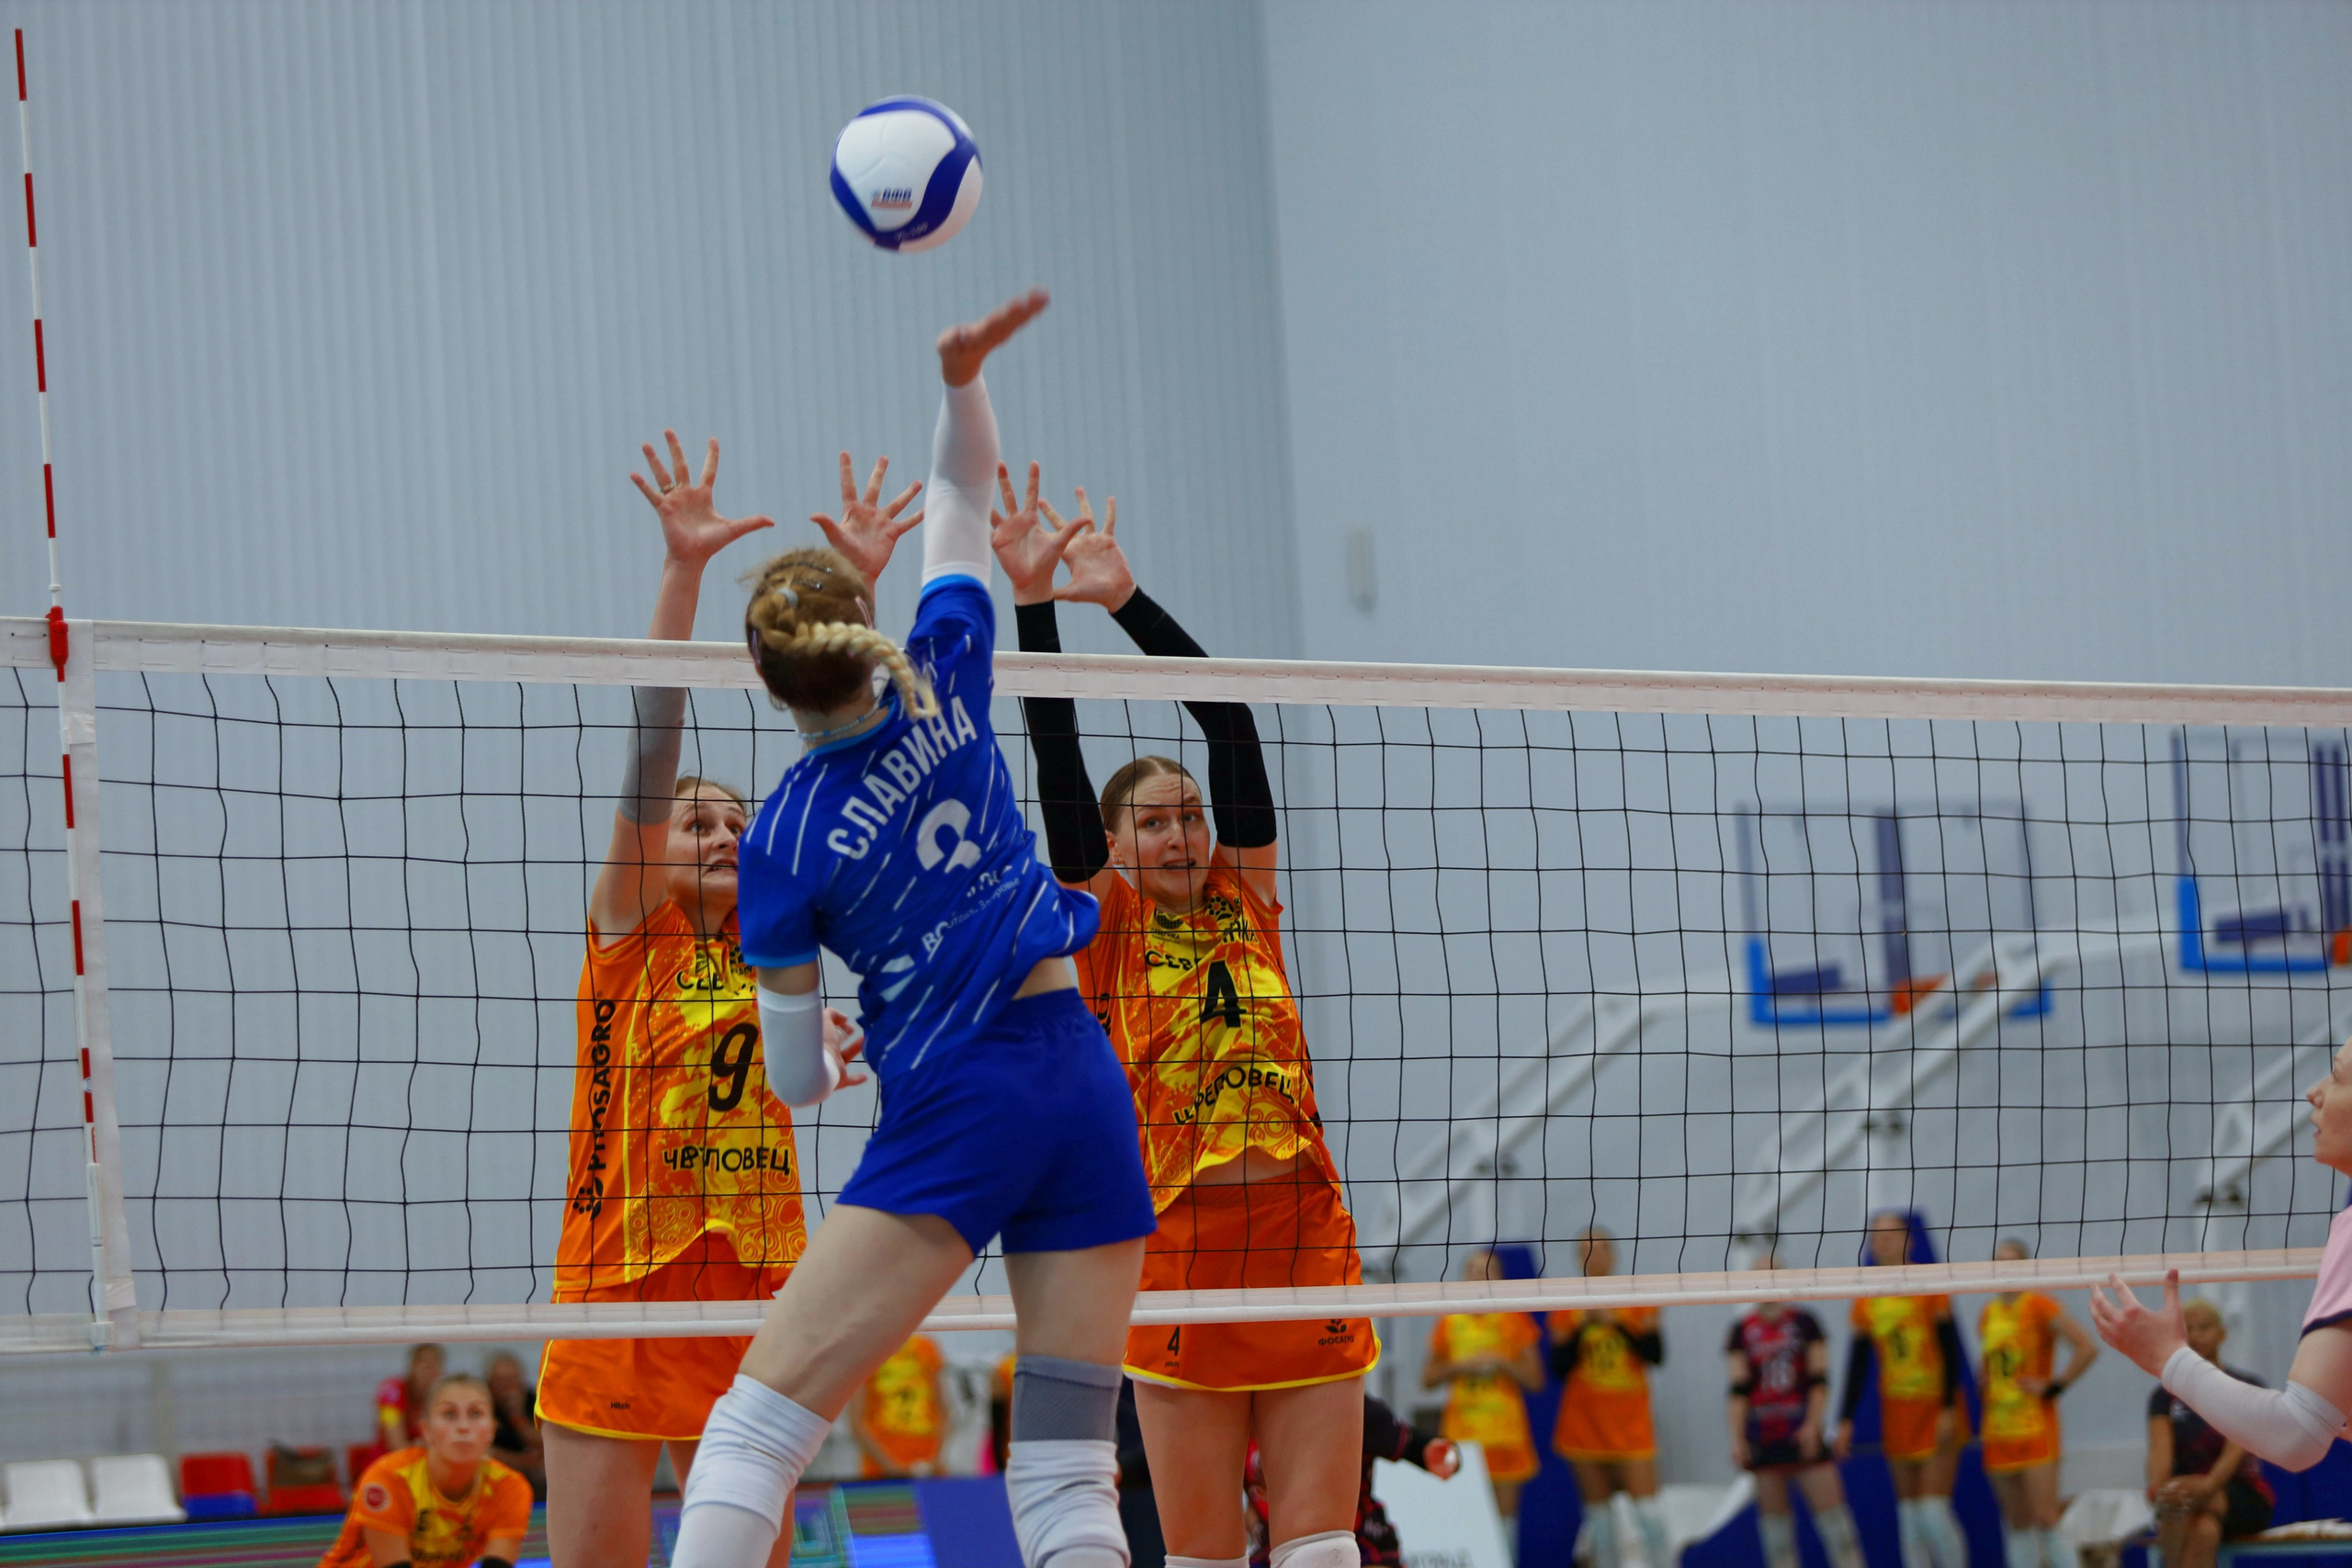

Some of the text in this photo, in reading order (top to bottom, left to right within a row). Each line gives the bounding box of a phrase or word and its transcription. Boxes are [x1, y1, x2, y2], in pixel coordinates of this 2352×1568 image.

[827, 695, 978, 860] СЛАВИНА
[707, 1021, 761, 1112] 9
[1167, 1325, 1180, 1356] 4
